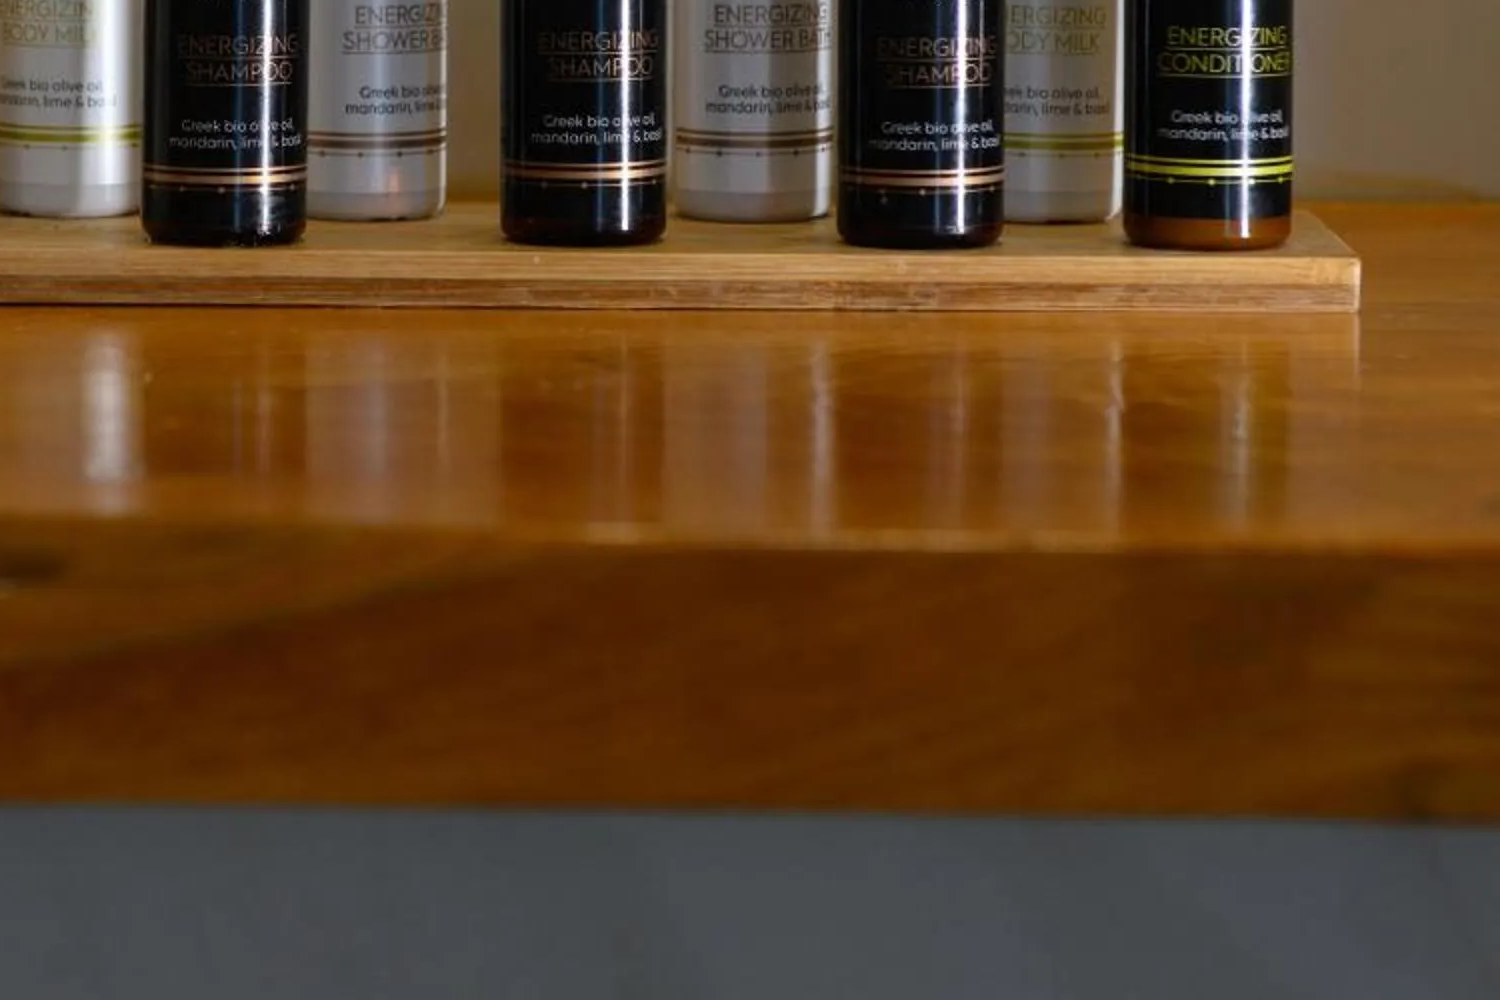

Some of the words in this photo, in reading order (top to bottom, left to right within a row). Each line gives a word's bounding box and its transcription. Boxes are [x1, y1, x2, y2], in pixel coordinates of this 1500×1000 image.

[1007, 4, 1107, 25] ERGIZING
[343, 29, 429, 51] SHOWER
[704, 29, 793, 50] SHOWER
[1006, 30, 1048, 51] ODY
[1055, 30, 1101, 51] MILK
[1167, 25, 1288, 47] ENERGZING
[876, 36, 996, 58] ENERGIING
[925, 120, 948, 135] bio
